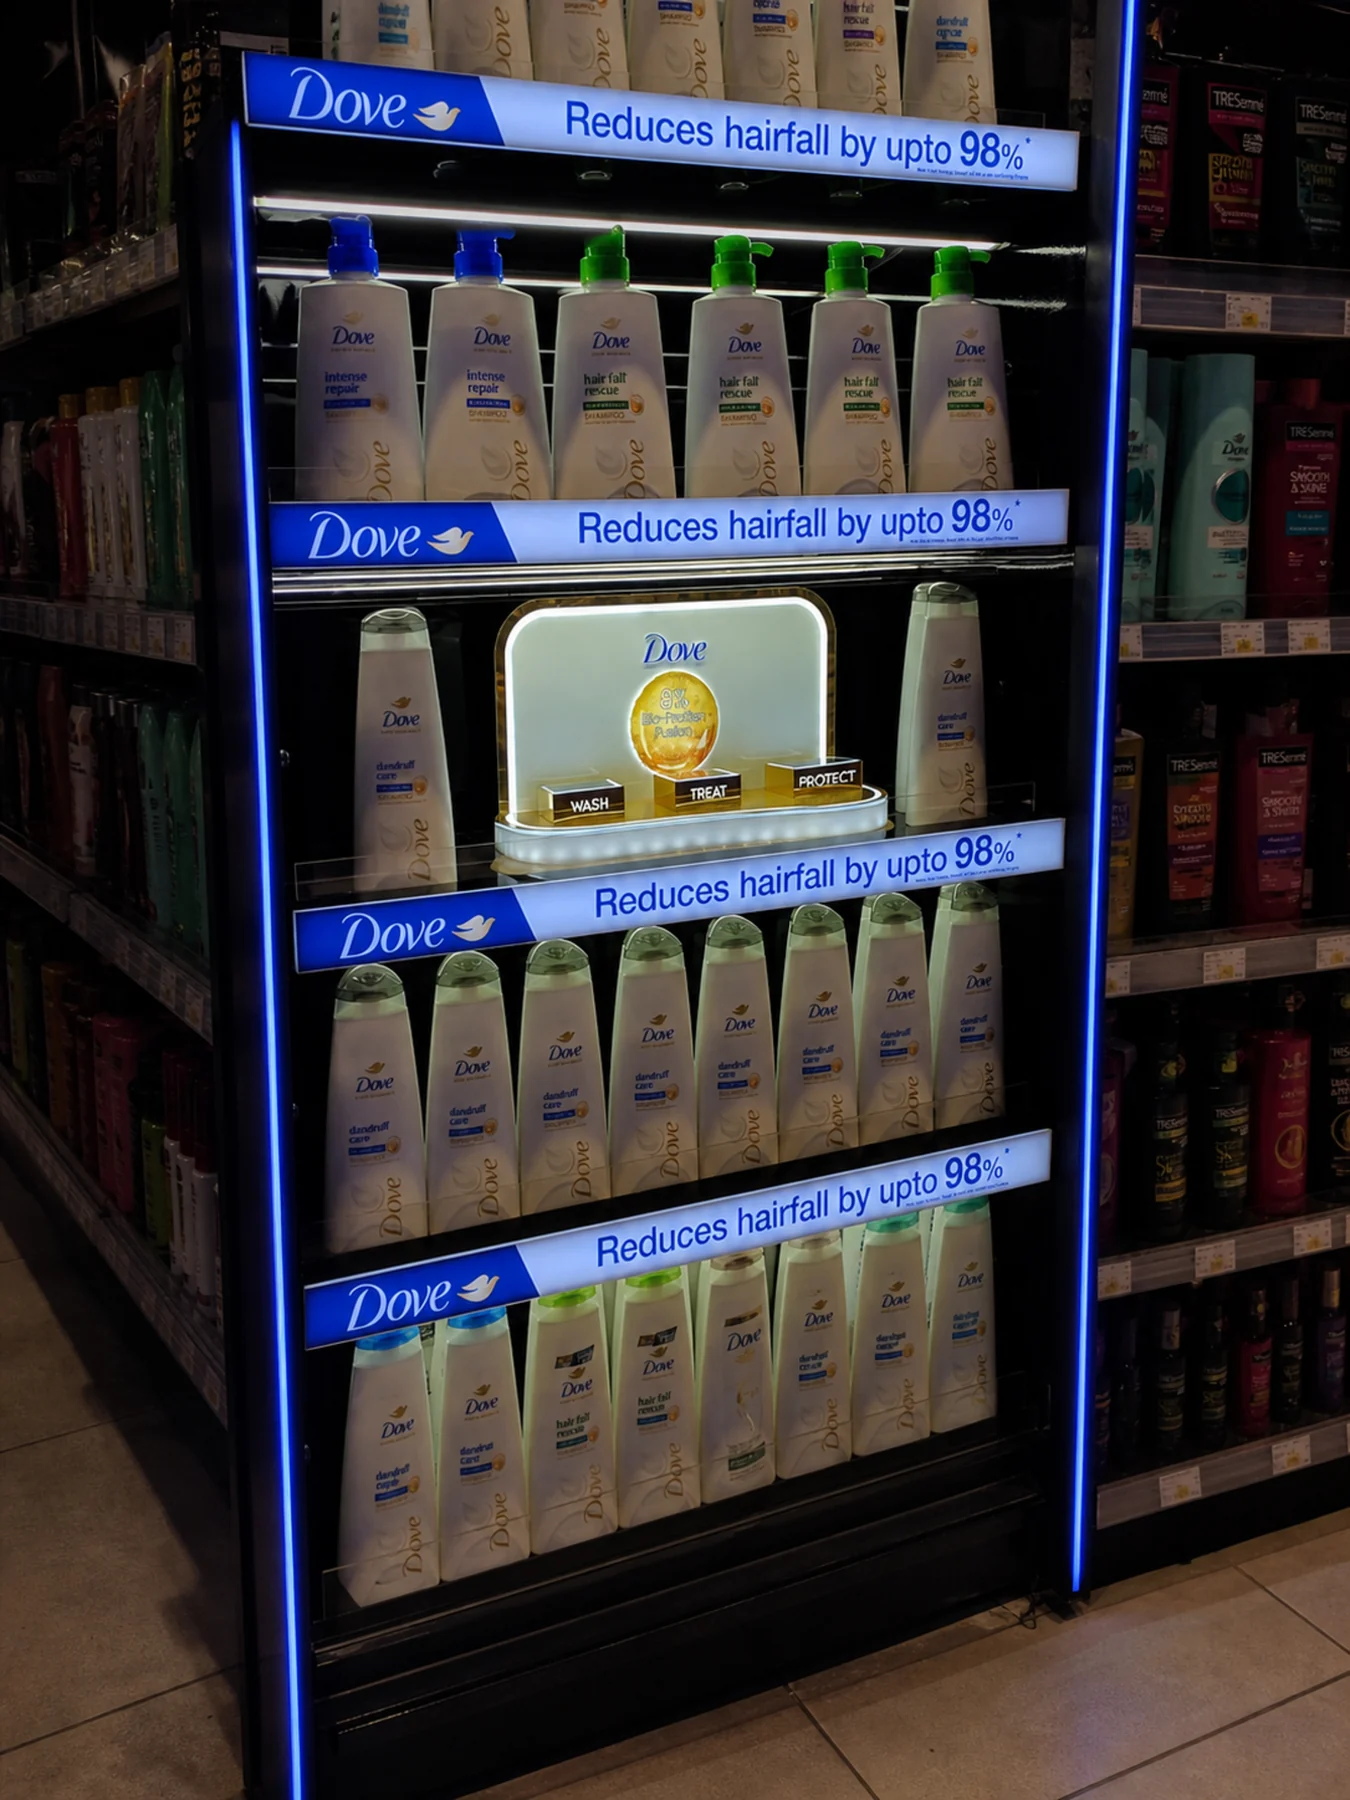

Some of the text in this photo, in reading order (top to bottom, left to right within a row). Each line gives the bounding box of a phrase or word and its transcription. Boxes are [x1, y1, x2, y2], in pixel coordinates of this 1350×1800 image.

[288, 66, 407, 129] Dove
[566, 100, 713, 146] Reduces
[725, 115, 829, 156] hairfall
[840, 125, 876, 167] by
[886, 133, 951, 169] upto
[332, 326, 375, 345] Dove
[474, 326, 511, 346] Dove
[592, 331, 630, 349] Dove
[728, 336, 762, 353] Dove
[851, 337, 881, 354] Dove
[955, 340, 986, 356] Dove
[325, 371, 367, 382] intense
[467, 369, 506, 381] intense
[583, 372, 627, 385] hair fall
[719, 376, 759, 387] hair fall
[844, 377, 879, 388] hair fall
[948, 377, 983, 388] hair fall
[325, 383, 359, 396] repair
[468, 383, 499, 396] repair
[584, 386, 619, 396] rescue
[720, 388, 752, 399] rescue
[845, 389, 873, 398] rescue
[948, 389, 977, 398] rescue
[366, 440, 393, 501] Dove
[511, 439, 531, 500] Dove
[624, 439, 646, 498] Dove
[759, 440, 778, 497] Dove
[879, 438, 894, 494] Dove
[981, 437, 998, 491] Dove
[308, 511, 421, 559] Dove
[578, 507, 718, 545] Reduces
[729, 508, 826, 539] hairfall
[837, 508, 871, 543] by
[881, 509, 943, 540] upto
[643, 633, 707, 664] Dove
[943, 670, 972, 685] Dove
[660, 688, 690, 709] 8%
[382, 711, 420, 728] Dove
[653, 725, 693, 740] Fusion
[376, 760, 415, 771] dandruff
[376, 772, 398, 781] care
[799, 770, 856, 789] PROTECT
[690, 784, 727, 800] TREAT
[959, 762, 976, 817] Dove
[570, 797, 609, 812] WASH
[408, 818, 431, 882] Dove
[594, 883, 729, 918] Reduces
[740, 859, 834, 898] hairfall
[845, 857, 878, 888] by
[888, 848, 947, 882] upto
[339, 912, 446, 960] Dove
[966, 974, 992, 989] Dove
[887, 988, 916, 1003] Dove
[808, 1003, 838, 1018] Dove
[724, 1017, 756, 1032] Dove
[642, 1027, 674, 1043] Dove
[549, 1045, 582, 1060] Dove
[455, 1059, 490, 1076] Dove
[718, 1059, 751, 1071] dandruff
[356, 1077, 394, 1093] Dove
[635, 1070, 669, 1082] dandruff
[543, 1088, 578, 1101] dandruff
[980, 1062, 995, 1113] Dove
[450, 1104, 486, 1117] dandruff
[902, 1075, 919, 1130] Dove
[349, 1121, 389, 1135] dandruff
[826, 1094, 844, 1147] Dove
[742, 1109, 761, 1165] Dove
[660, 1121, 680, 1178] Dove
[571, 1141, 592, 1198] Dove
[477, 1158, 499, 1218] Dove
[379, 1177, 402, 1239] Dove
[597, 1219, 728, 1267] Reduces
[738, 1198, 829, 1236] hairfall
[839, 1184, 871, 1217] by
[880, 1171, 937, 1206] upto
[958, 1272, 984, 1288] Dove
[347, 1283, 451, 1332] Dove
[882, 1293, 911, 1308] Dove
[804, 1311, 834, 1327] Dove
[727, 1328, 761, 1351] Dove
[643, 1359, 675, 1375] Dove
[561, 1379, 593, 1398] Dove
[465, 1397, 498, 1415] Dove
[896, 1378, 914, 1430] Dove
[381, 1418, 414, 1439] Dove
[822, 1398, 839, 1452] Dove
[664, 1443, 684, 1498] Dove
[584, 1465, 605, 1524] Dove
[490, 1493, 510, 1552] Dove
[402, 1516, 423, 1577] Dove
